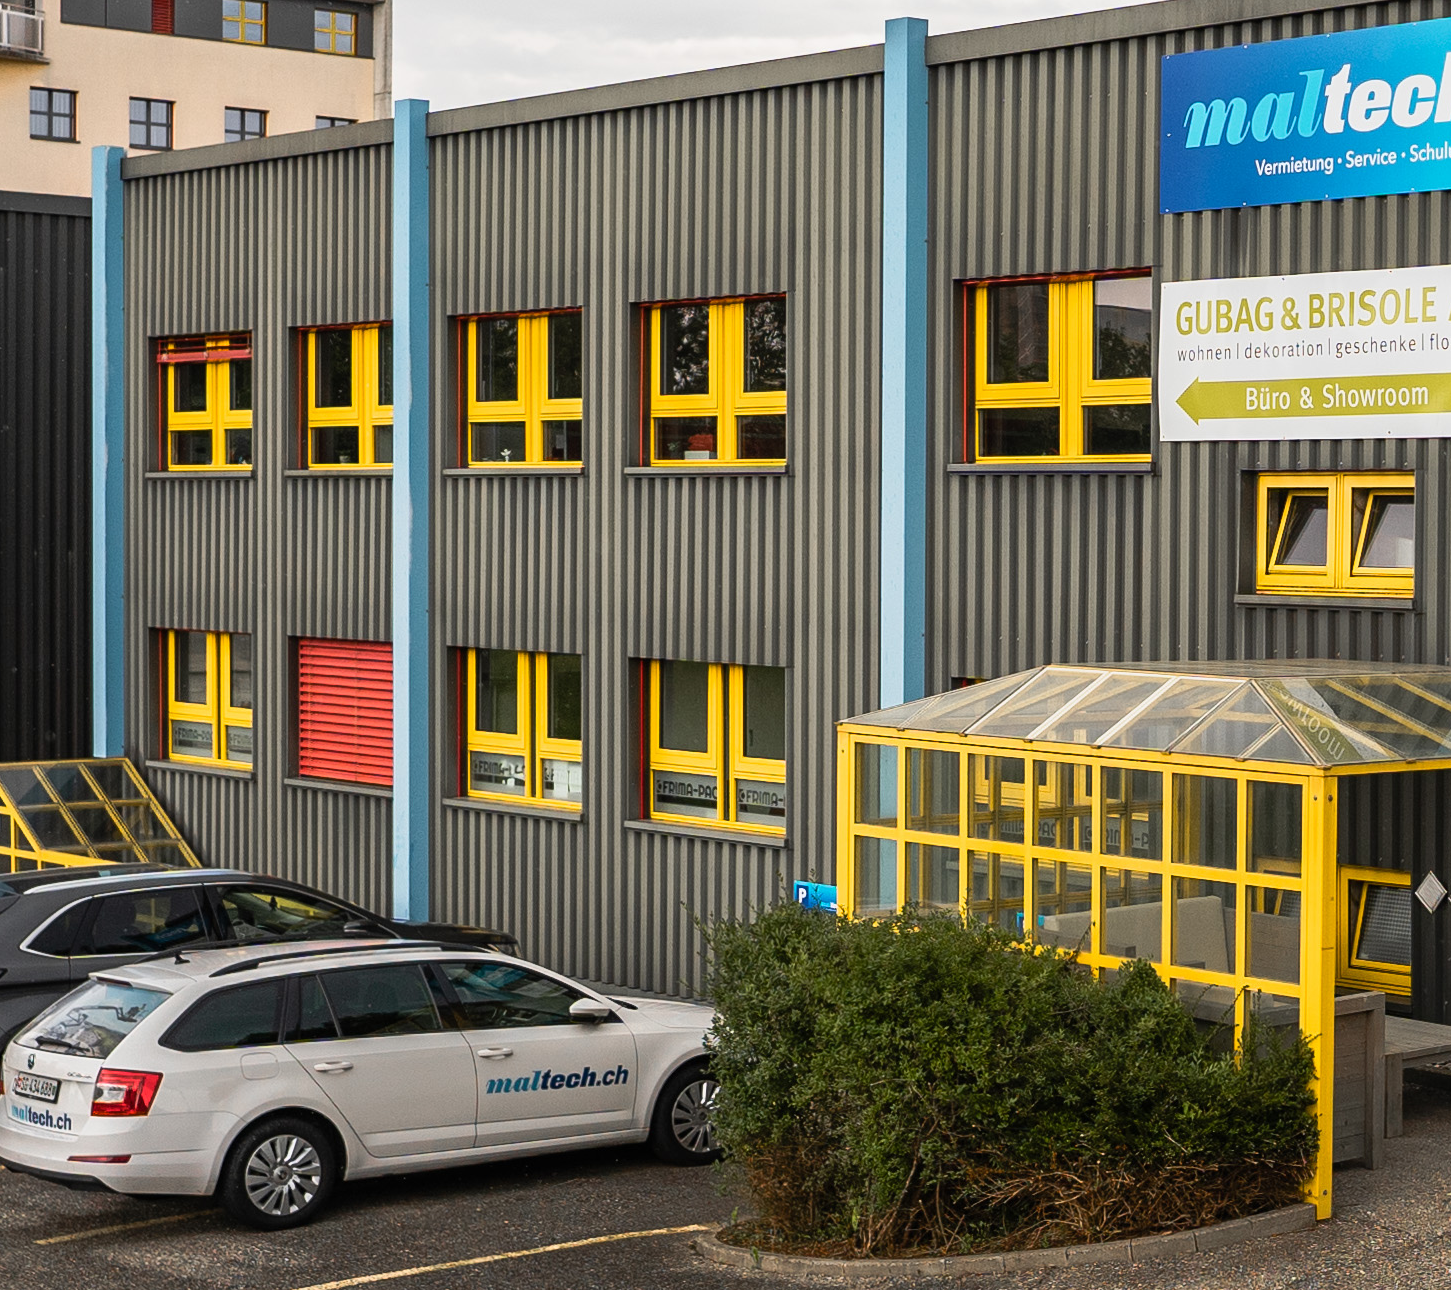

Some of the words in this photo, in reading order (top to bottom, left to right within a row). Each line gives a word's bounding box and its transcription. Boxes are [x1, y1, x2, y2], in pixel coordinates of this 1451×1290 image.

[1255, 154, 1334, 177] Vermietung
[1345, 149, 1397, 169] Service
[1176, 296, 1274, 336] GUBAG
[1281, 295, 1302, 330] &
[1309, 286, 1437, 329] BRISOLE
[1177, 343, 1232, 362] wohnen
[1244, 339, 1324, 360] dekoration
[1335, 335, 1416, 358] geschenke
[1245, 385, 1291, 411] Büro
[1299, 386, 1314, 408] &
[1322, 383, 1429, 408] Showroom
[746, 790, 786, 807] FRIMA-
[798, 887, 807, 904] P
[486, 1065, 629, 1095] maltech.ch
[11, 1104, 72, 1131] maltech.ch
